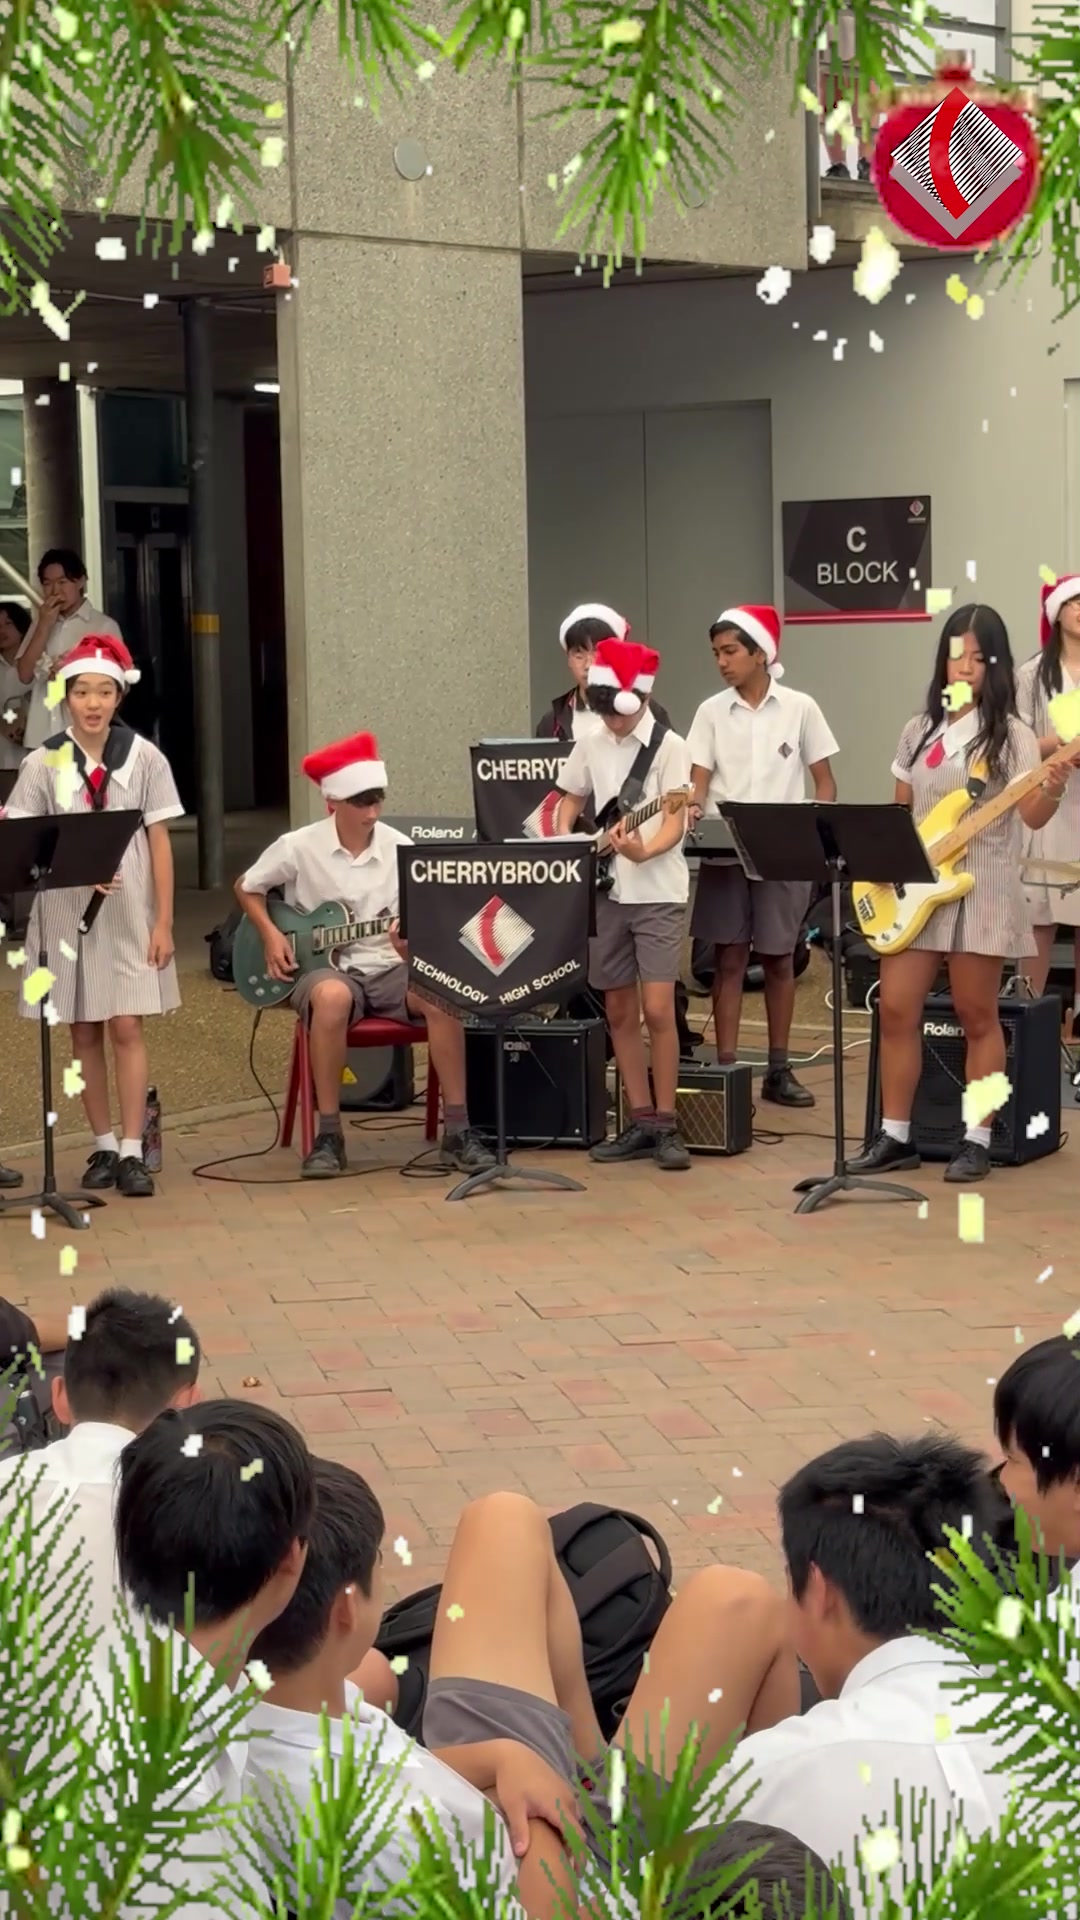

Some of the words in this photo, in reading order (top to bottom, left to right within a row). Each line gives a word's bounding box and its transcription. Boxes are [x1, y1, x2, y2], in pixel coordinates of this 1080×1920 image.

[846, 525, 867, 553] C
[816, 560, 899, 585] BLOCK
[411, 826, 464, 839] Roland
[410, 859, 582, 884] CHERRYBROOK
[412, 956, 489, 1005] TECHNOLOGY
[499, 984, 531, 1006] HIGH
[532, 958, 581, 991] SCHOOL
[923, 1022, 965, 1037] Rolan
